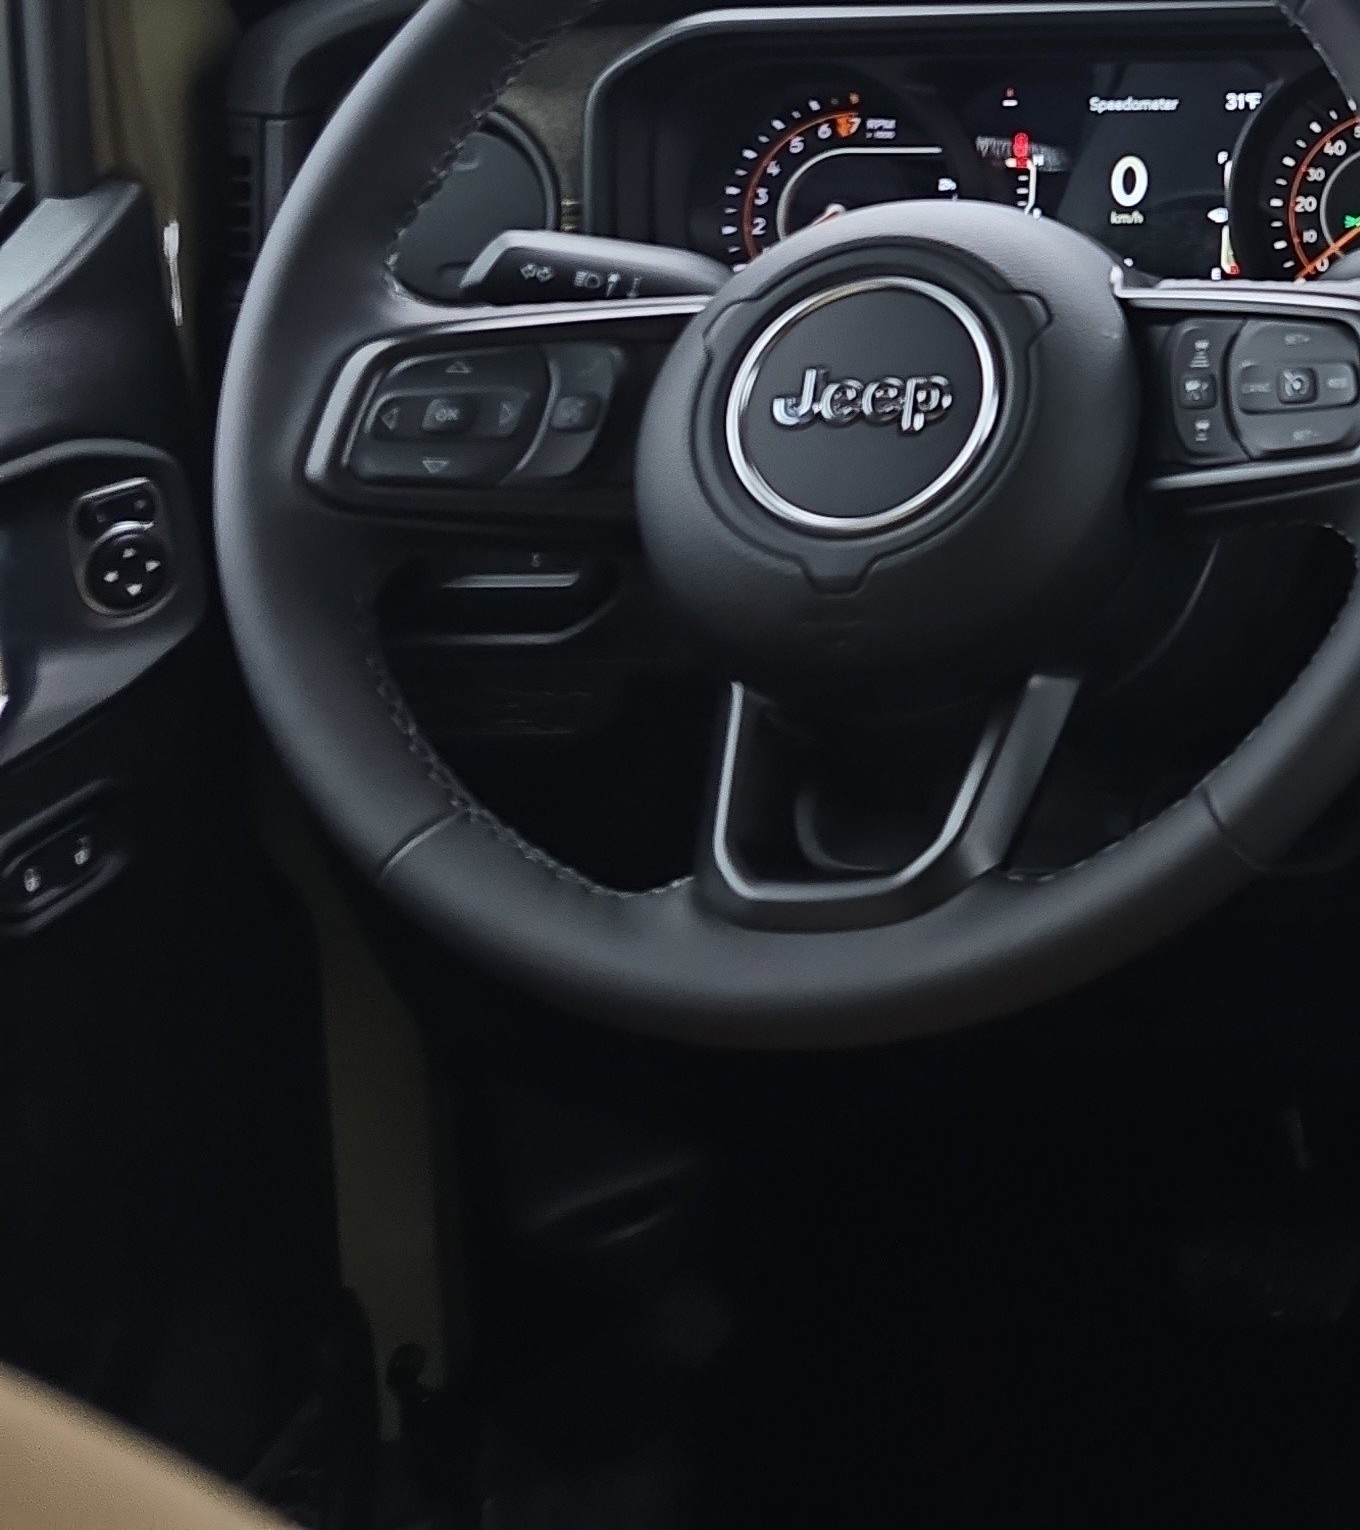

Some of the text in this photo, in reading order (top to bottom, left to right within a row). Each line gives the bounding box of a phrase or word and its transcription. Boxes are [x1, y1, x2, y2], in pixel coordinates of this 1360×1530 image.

[1088, 95, 1180, 113] Speedometer
[817, 122, 833, 139] 6
[788, 136, 805, 154] 5
[1323, 139, 1348, 157] 40
[766, 160, 781, 177] 4
[1306, 167, 1326, 182] 30
[1110, 155, 1149, 207] 0
[755, 187, 770, 206] 3
[1294, 196, 1318, 212] 20
[751, 217, 767, 236] 2
[1109, 211, 1145, 224] km/h
[1302, 229, 1318, 244] 10
[772, 368, 953, 432] Jeep
